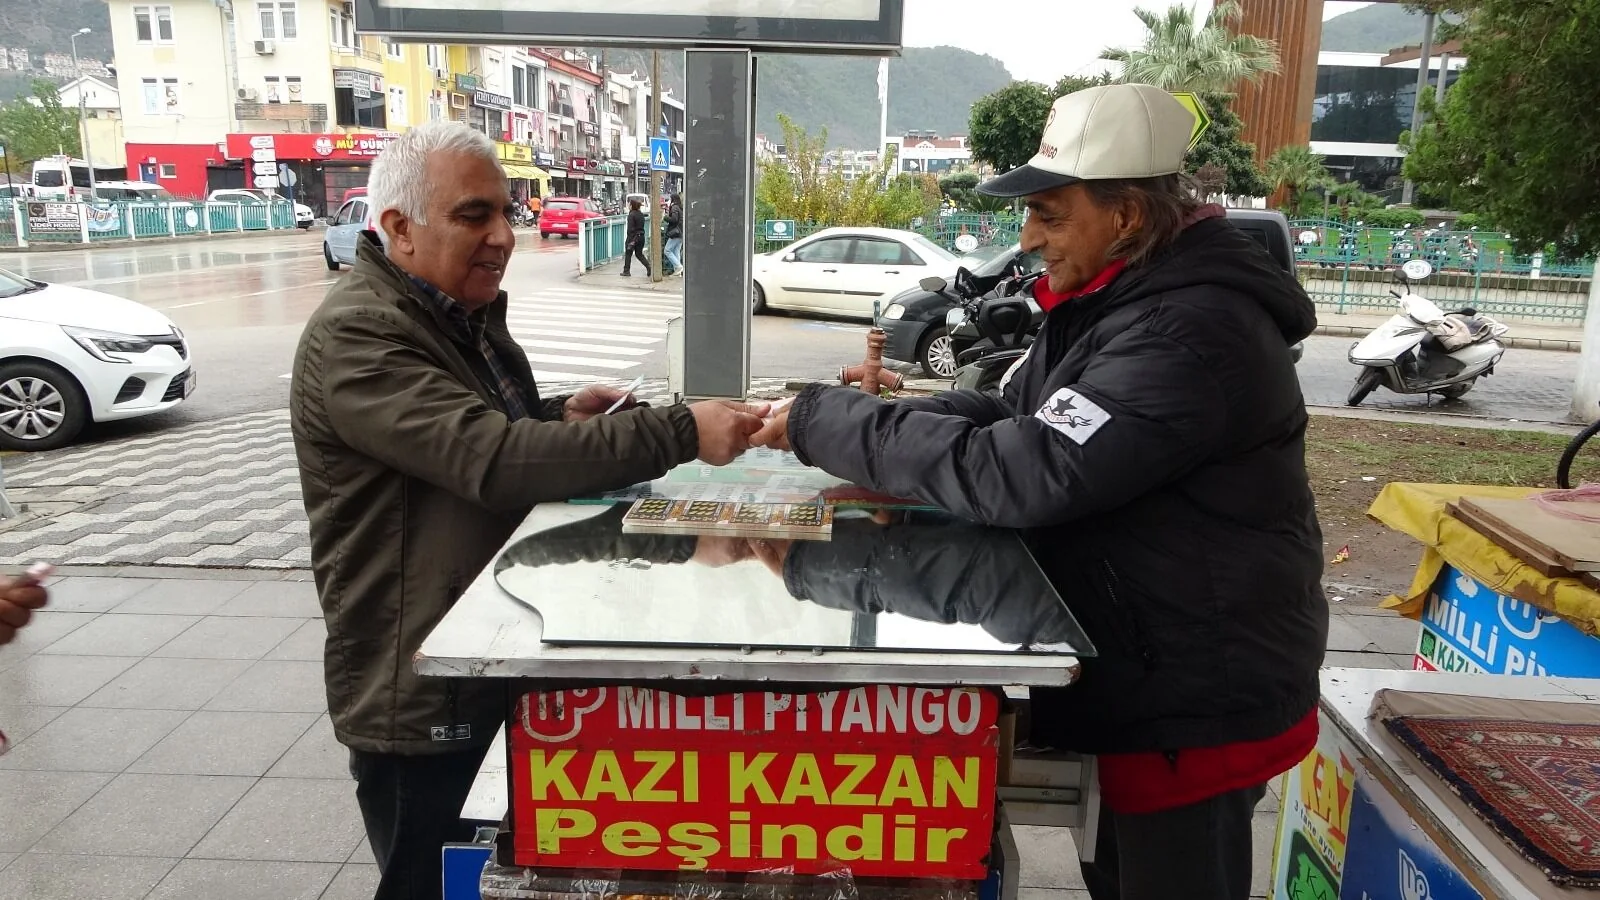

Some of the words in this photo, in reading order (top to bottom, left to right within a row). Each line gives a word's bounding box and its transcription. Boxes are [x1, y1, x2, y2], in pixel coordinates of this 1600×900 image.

[1427, 592, 1499, 666] MİLLİ
[529, 748, 699, 803] KAZI
[730, 751, 981, 808] KAZAN
[535, 808, 968, 870] Peşindir
